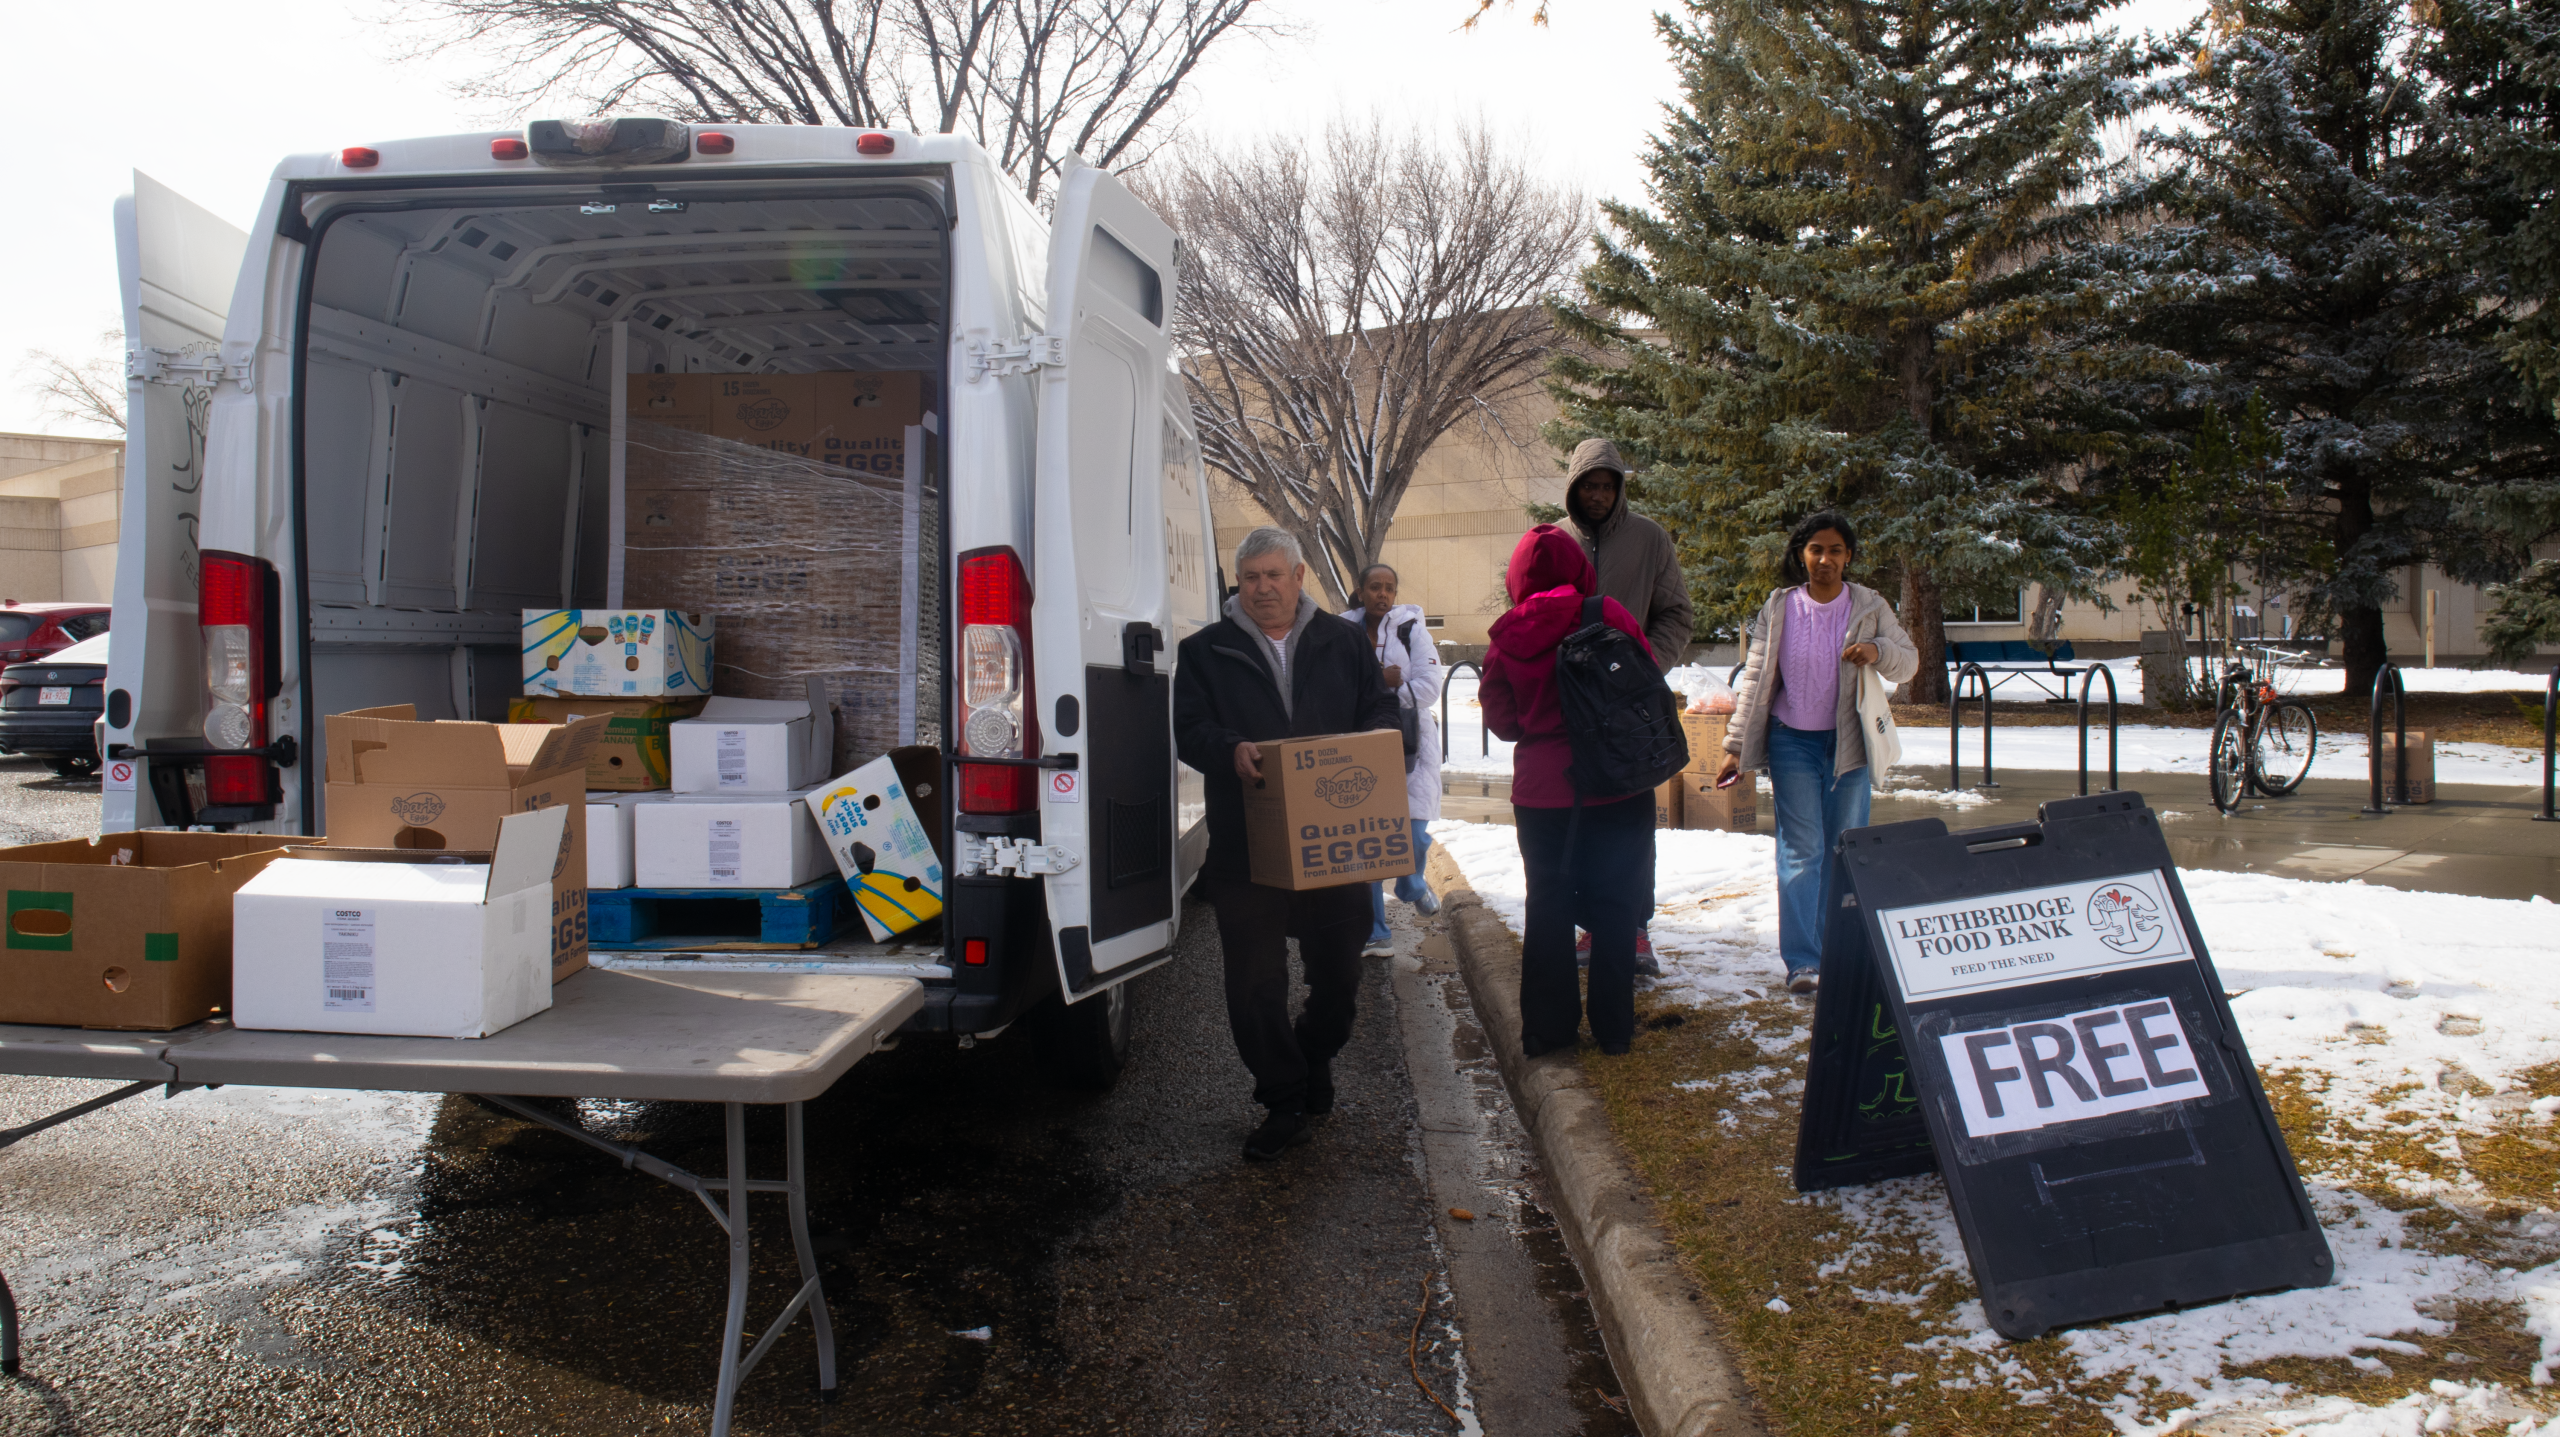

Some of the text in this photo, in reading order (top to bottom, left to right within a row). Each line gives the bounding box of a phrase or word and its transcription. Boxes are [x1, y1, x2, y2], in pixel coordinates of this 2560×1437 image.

[722, 380, 740, 397] 15
[742, 381, 760, 389] DOZEN
[736, 402, 791, 427] Sparks
[824, 437, 904, 450] Qualit
[1166, 516, 1199, 595] BANK
[1294, 750, 1316, 771] 15
[1318, 747, 1339, 758] DOZEN
[1318, 755, 1353, 767] DOUZAINES
[1314, 771, 1378, 802] Sparks
[390, 796, 446, 818] Sparks
[1338, 793, 1361, 804] Eggs
[1732, 805, 1756, 814] Quality
[410, 813, 429, 823] Eggs
[835, 812, 852, 836] best
[840, 798, 859, 828] snack
[850, 800, 869, 827] ever
[1732, 812, 1757, 825] EGGS
[1300, 816, 1406, 841] Quality
[1300, 833, 1409, 869] EGGS
[1303, 857, 1410, 879] from ALBERTA Farms
[552, 887, 587, 916] ality
[335, 910, 362, 918] COSTCO
[1897, 895, 2075, 940] LETHBRIDGE
[1915, 918, 2074, 959] FOOD BANK
[1950, 951, 2056, 977] FEED THE NEED
[1963, 1001, 2200, 1119] FREE
